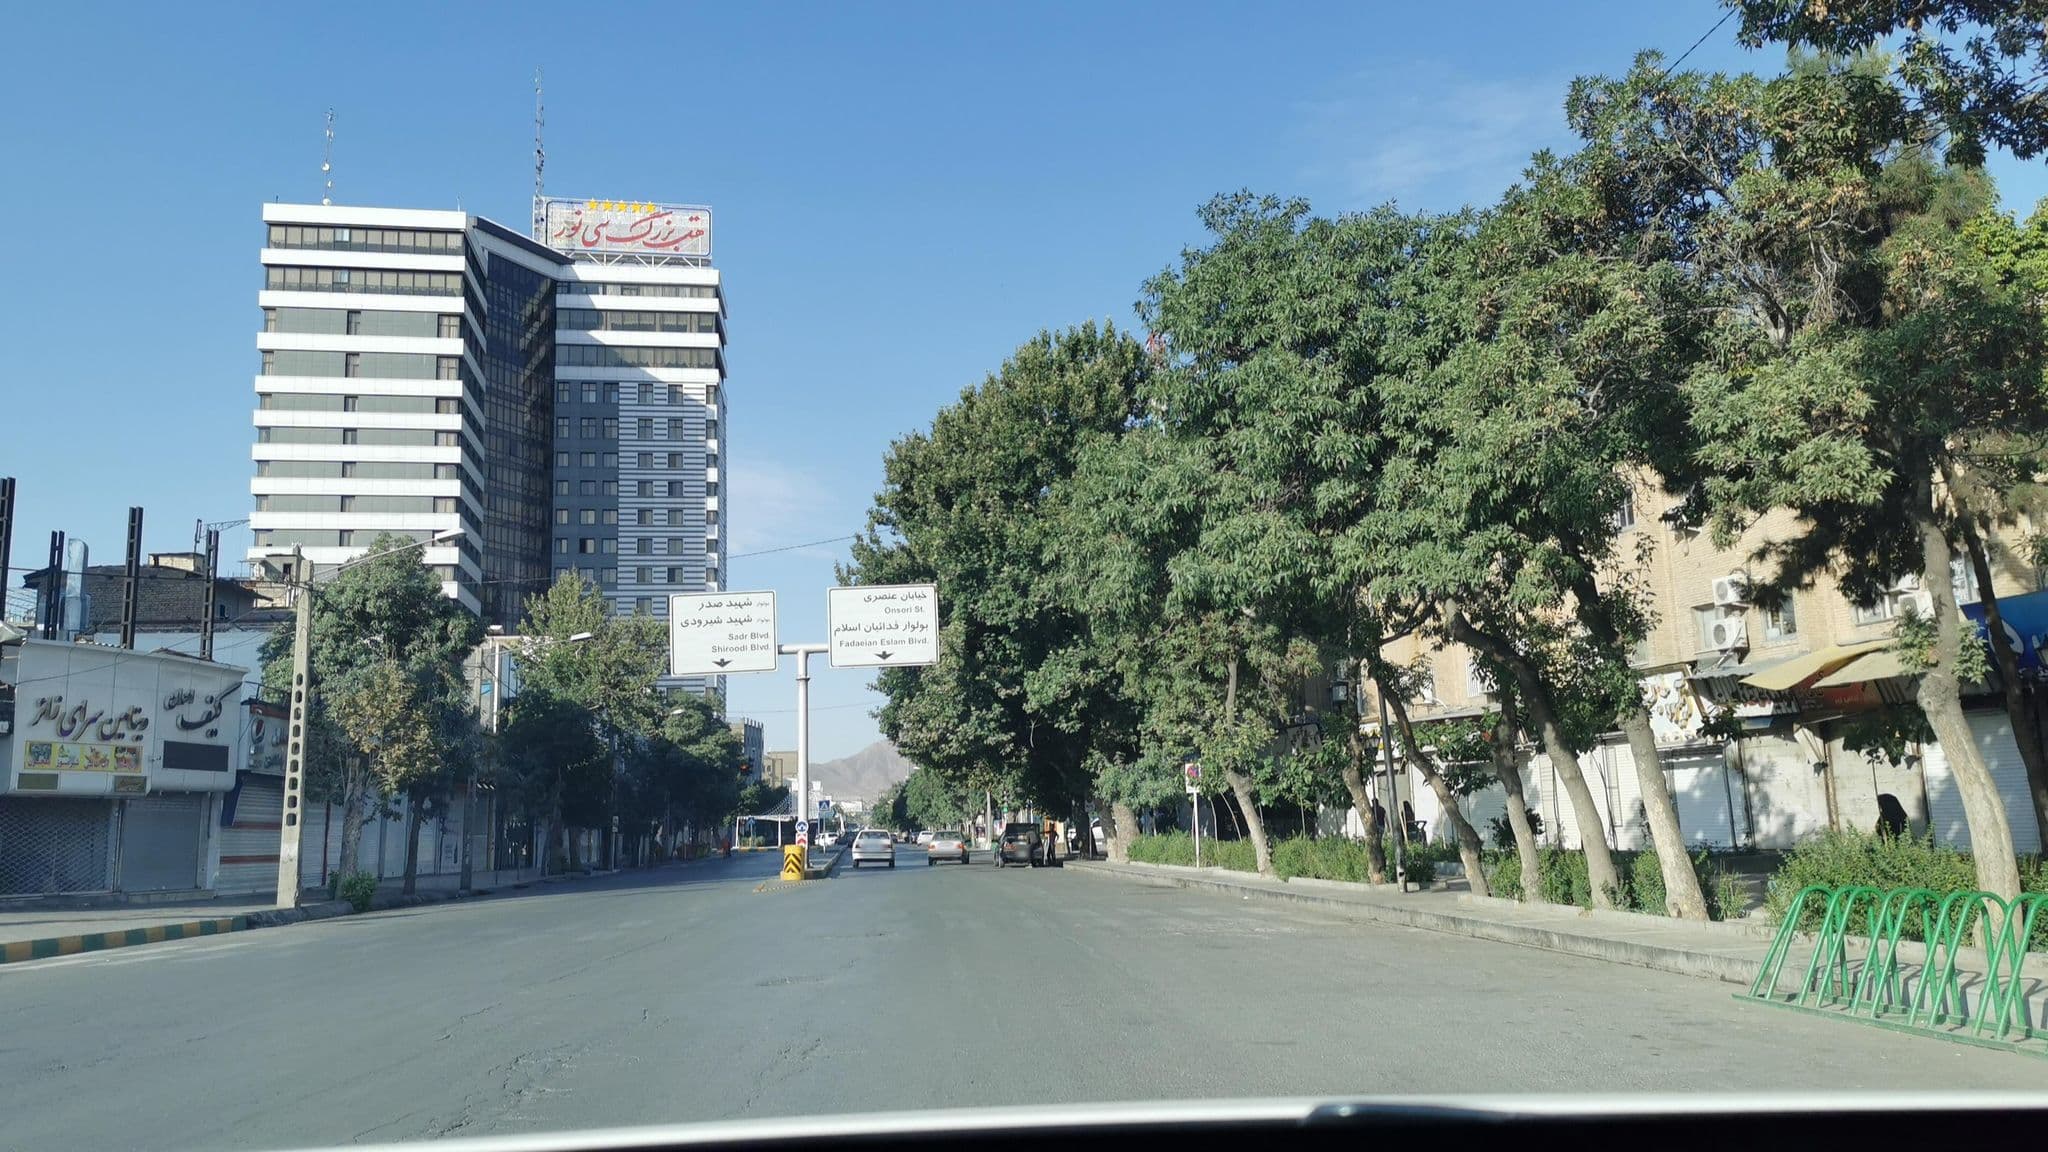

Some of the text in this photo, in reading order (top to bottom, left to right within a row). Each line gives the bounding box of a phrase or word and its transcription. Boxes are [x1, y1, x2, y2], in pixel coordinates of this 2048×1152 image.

[554, 210, 583, 238] نور
[606, 211, 680, 251] بزرگ
[863, 591, 927, 603] خیابان عنصری
[698, 600, 723, 611] صدر
[726, 598, 753, 609] شهید
[885, 606, 912, 614] Onsori
[680, 615, 723, 628] شیرودی
[726, 614, 753, 625] شهید
[833, 622, 861, 637] اسلام
[902, 621, 929, 632] بولوار
[728, 633, 748, 641] Sadr
[711, 644, 748, 653] Shiroodi
[839, 639, 878, 648] Fadaeian
[880, 638, 906, 647] Eslam
[56, 699, 105, 742] سرای
[96, 705, 149, 742] ویتامین
